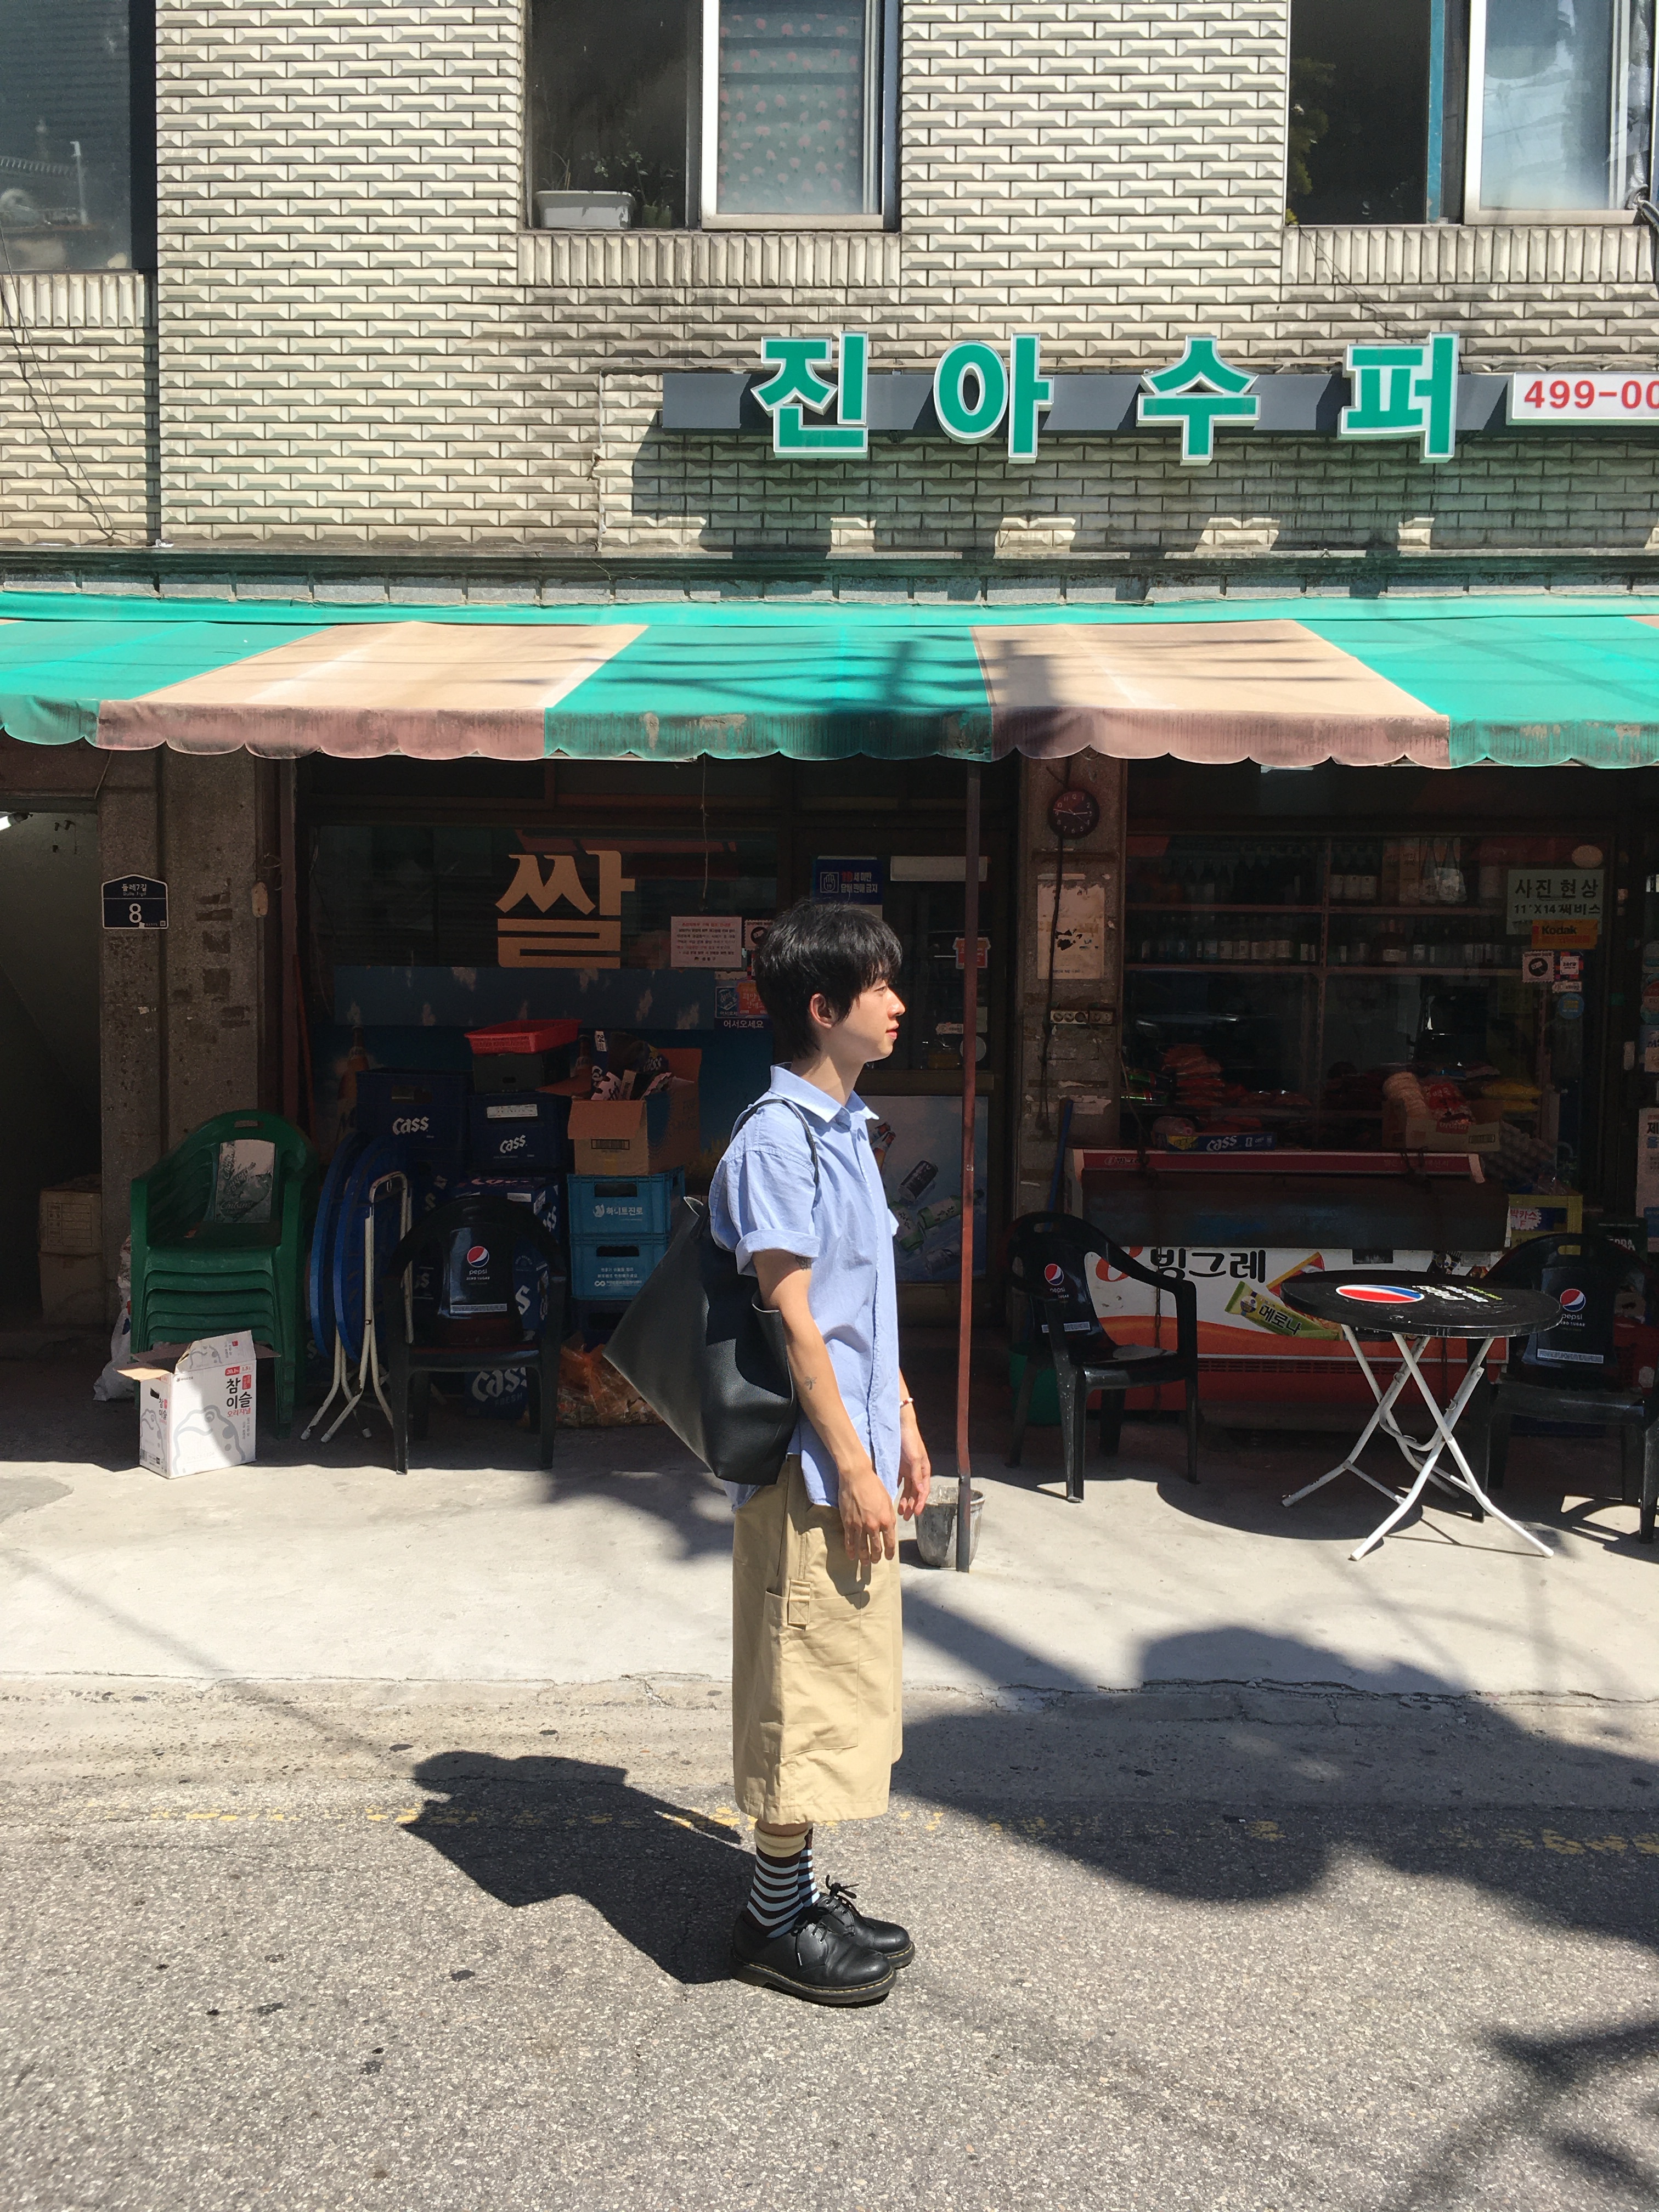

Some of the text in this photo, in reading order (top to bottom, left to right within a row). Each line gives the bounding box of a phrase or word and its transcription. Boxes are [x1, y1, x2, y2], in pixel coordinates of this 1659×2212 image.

[751, 330, 1460, 465] 진아수퍼
[1515, 879, 1599, 899] 사진 현상
[129, 903, 142, 923] 8
[495, 850, 635, 968] 쌀
[1542, 926, 1577, 935] Kodak
[723, 1019, 764, 1029] 어서오세요
[1510, 1209, 1537, 1220] 박카스
[1150, 1248, 1266, 1283] 빙그레
[1259, 1305, 1302, 1336] 메로나
[225, 1377, 241, 1395] 참
[226, 1391, 253, 1409] 이슬
